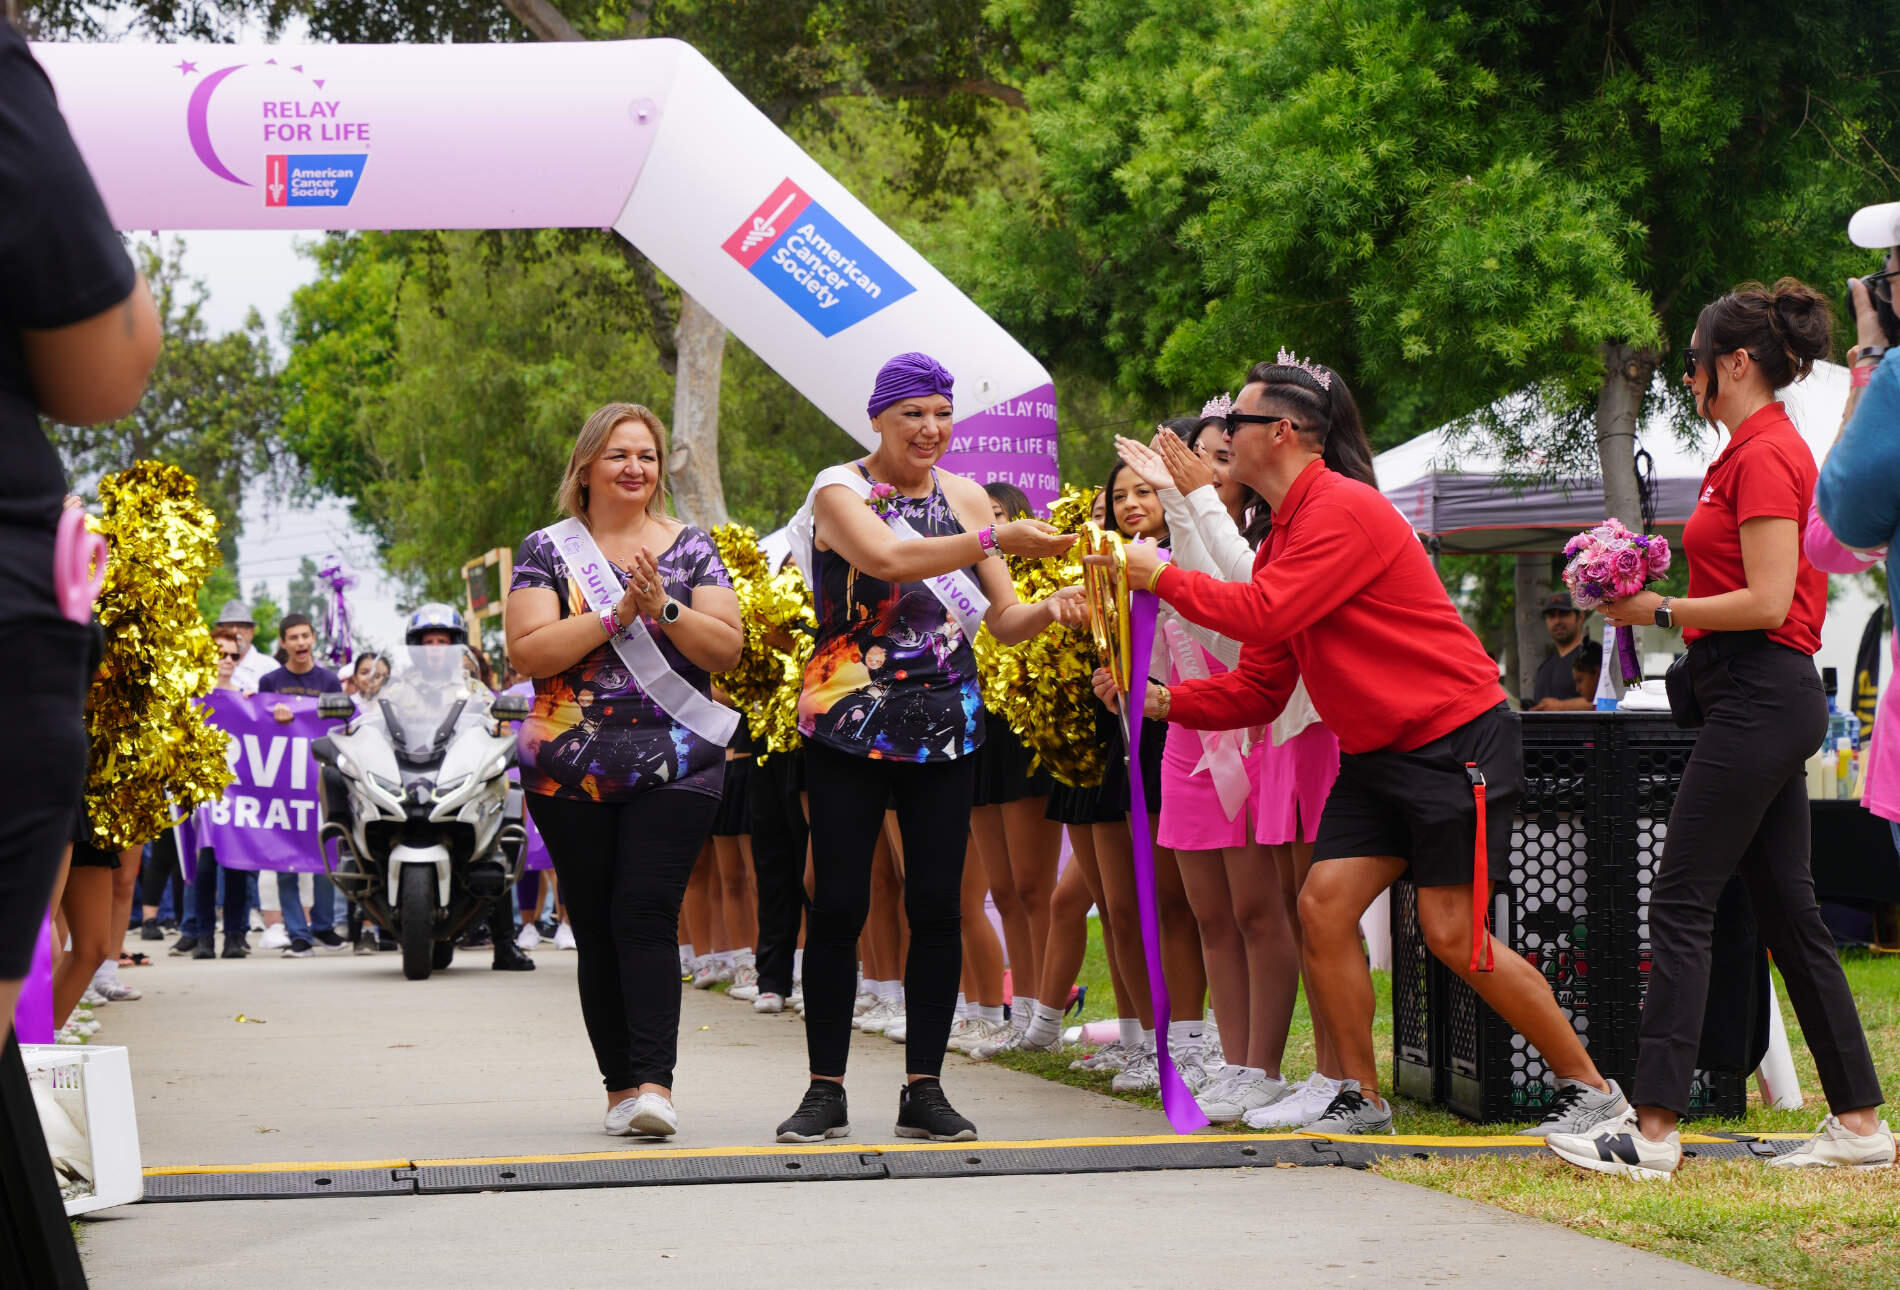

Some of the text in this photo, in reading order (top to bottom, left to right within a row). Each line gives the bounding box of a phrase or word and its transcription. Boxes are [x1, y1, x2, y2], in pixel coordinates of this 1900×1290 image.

[263, 101, 340, 118] RELAY
[264, 123, 370, 141] FOR LIFE
[291, 168, 354, 178] American
[291, 178, 336, 188] Cancer
[291, 187, 339, 198] Society
[786, 235, 849, 291] Cancer
[797, 223, 882, 299] American
[772, 247, 840, 309] Society
[978, 436, 1013, 453] FOR
[1016, 437, 1043, 454] LIFE
[986, 471, 1036, 489] RELAY
[581, 563, 612, 605] Surv
[936, 575, 978, 617] vivor
[227, 733, 309, 790] RVI
